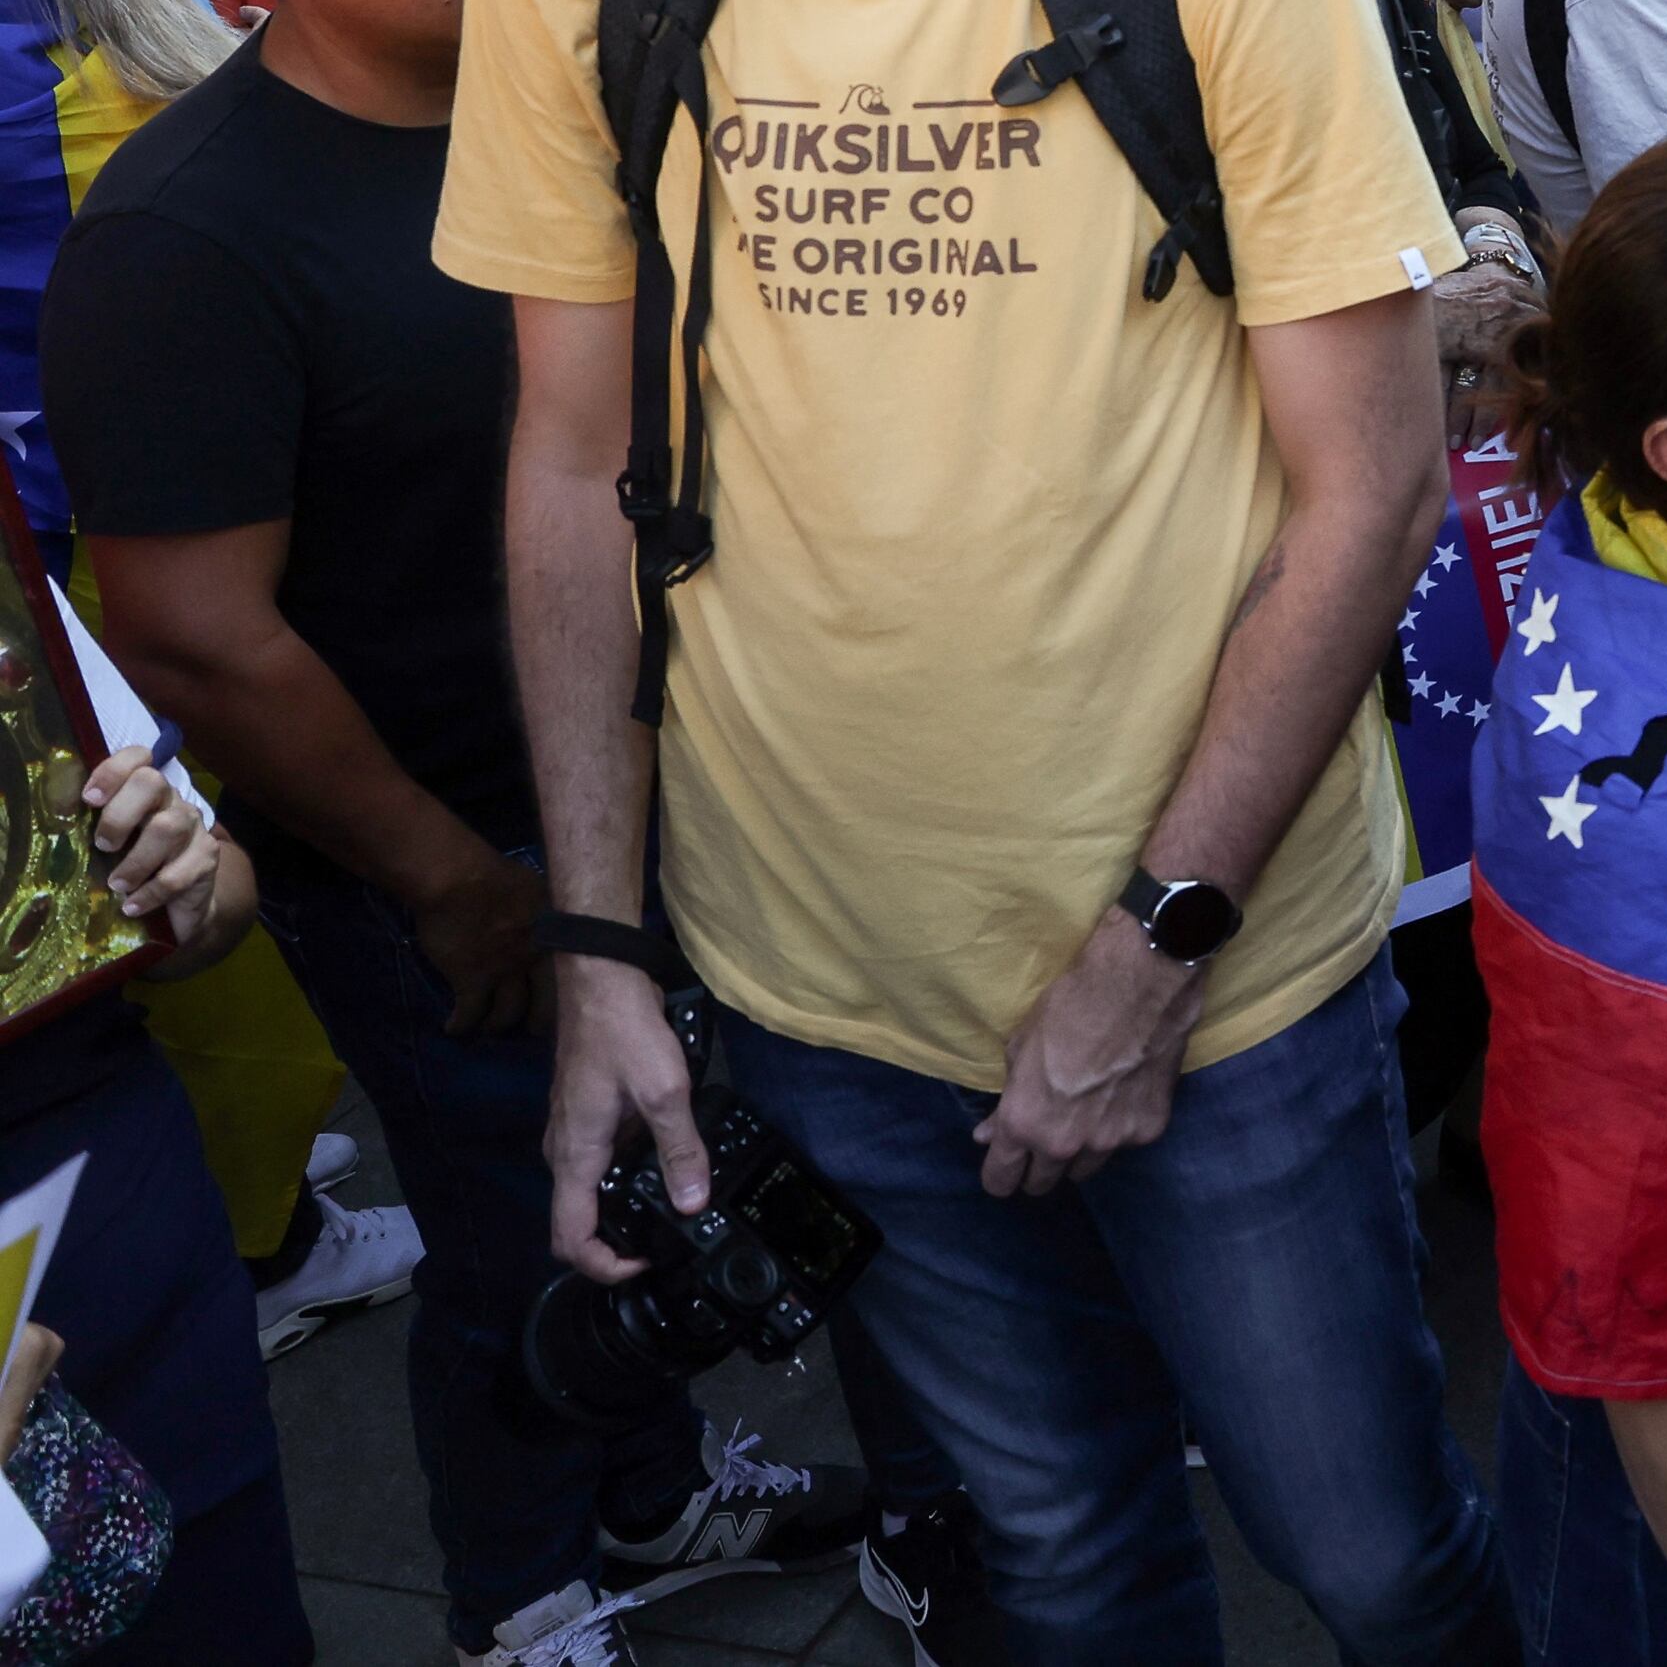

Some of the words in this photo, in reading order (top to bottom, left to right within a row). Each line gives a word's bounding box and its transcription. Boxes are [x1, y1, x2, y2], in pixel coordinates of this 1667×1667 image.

[755, 184, 890, 224] SURF
[909, 186, 973, 225] CO
[793, 237, 1038, 277] ORIGINAL
[759, 283, 868, 316] SINCE
[887, 288, 967, 318] 1969
